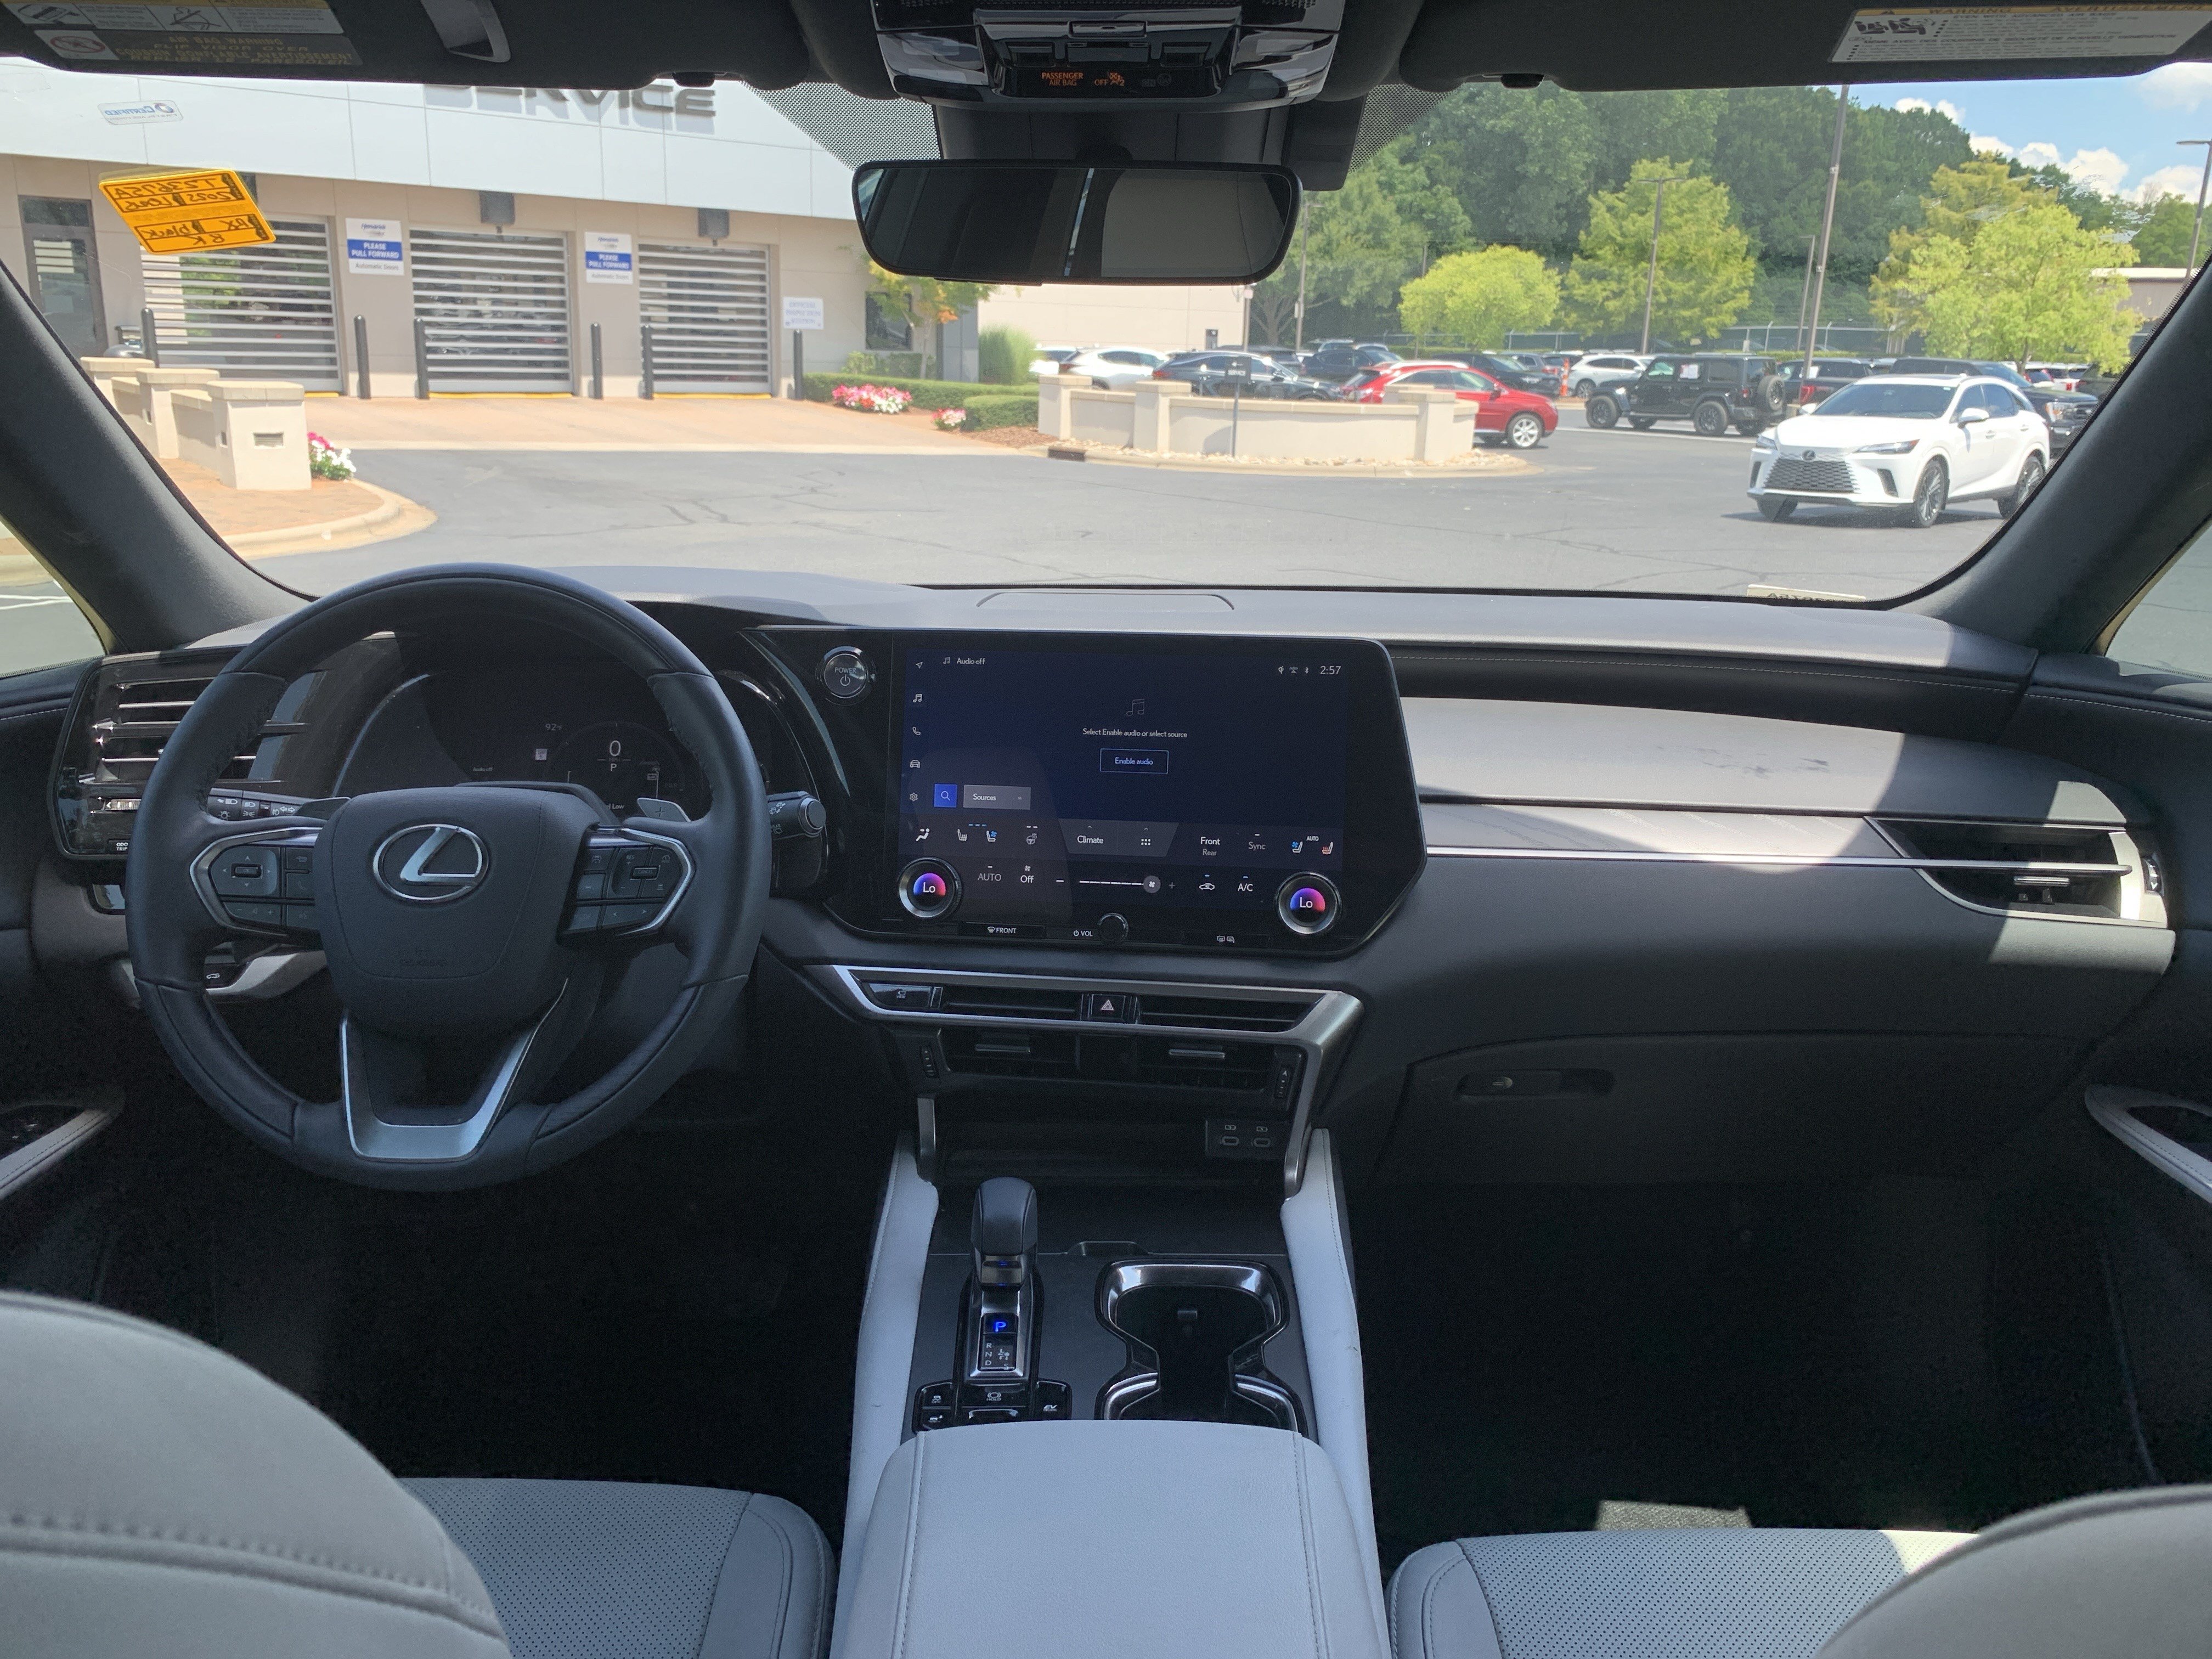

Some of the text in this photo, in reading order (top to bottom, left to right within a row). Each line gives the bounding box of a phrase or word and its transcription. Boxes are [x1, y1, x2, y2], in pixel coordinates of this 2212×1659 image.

[424, 83, 717, 117] VICE
[363, 242, 387, 250] PLEASE
[351, 249, 399, 259] PULL FORWARD
[602, 261, 630, 269] FORWARD
[1320, 665, 1341, 675] 2:57
[609, 740, 622, 757] 0
[611, 763, 617, 772] P
[1077, 835, 1104, 844] Climate
[1200, 836, 1221, 845] Front
[1249, 842, 1266, 850] Sync
[977, 873, 1002, 882] AUTO
[1020, 875, 1034, 883] Off
[923, 882, 936, 893] Lo
[1237, 883, 1254, 892] A/C
[1300, 896, 1313, 909] Lo
[995, 1322, 1006, 1332] P
